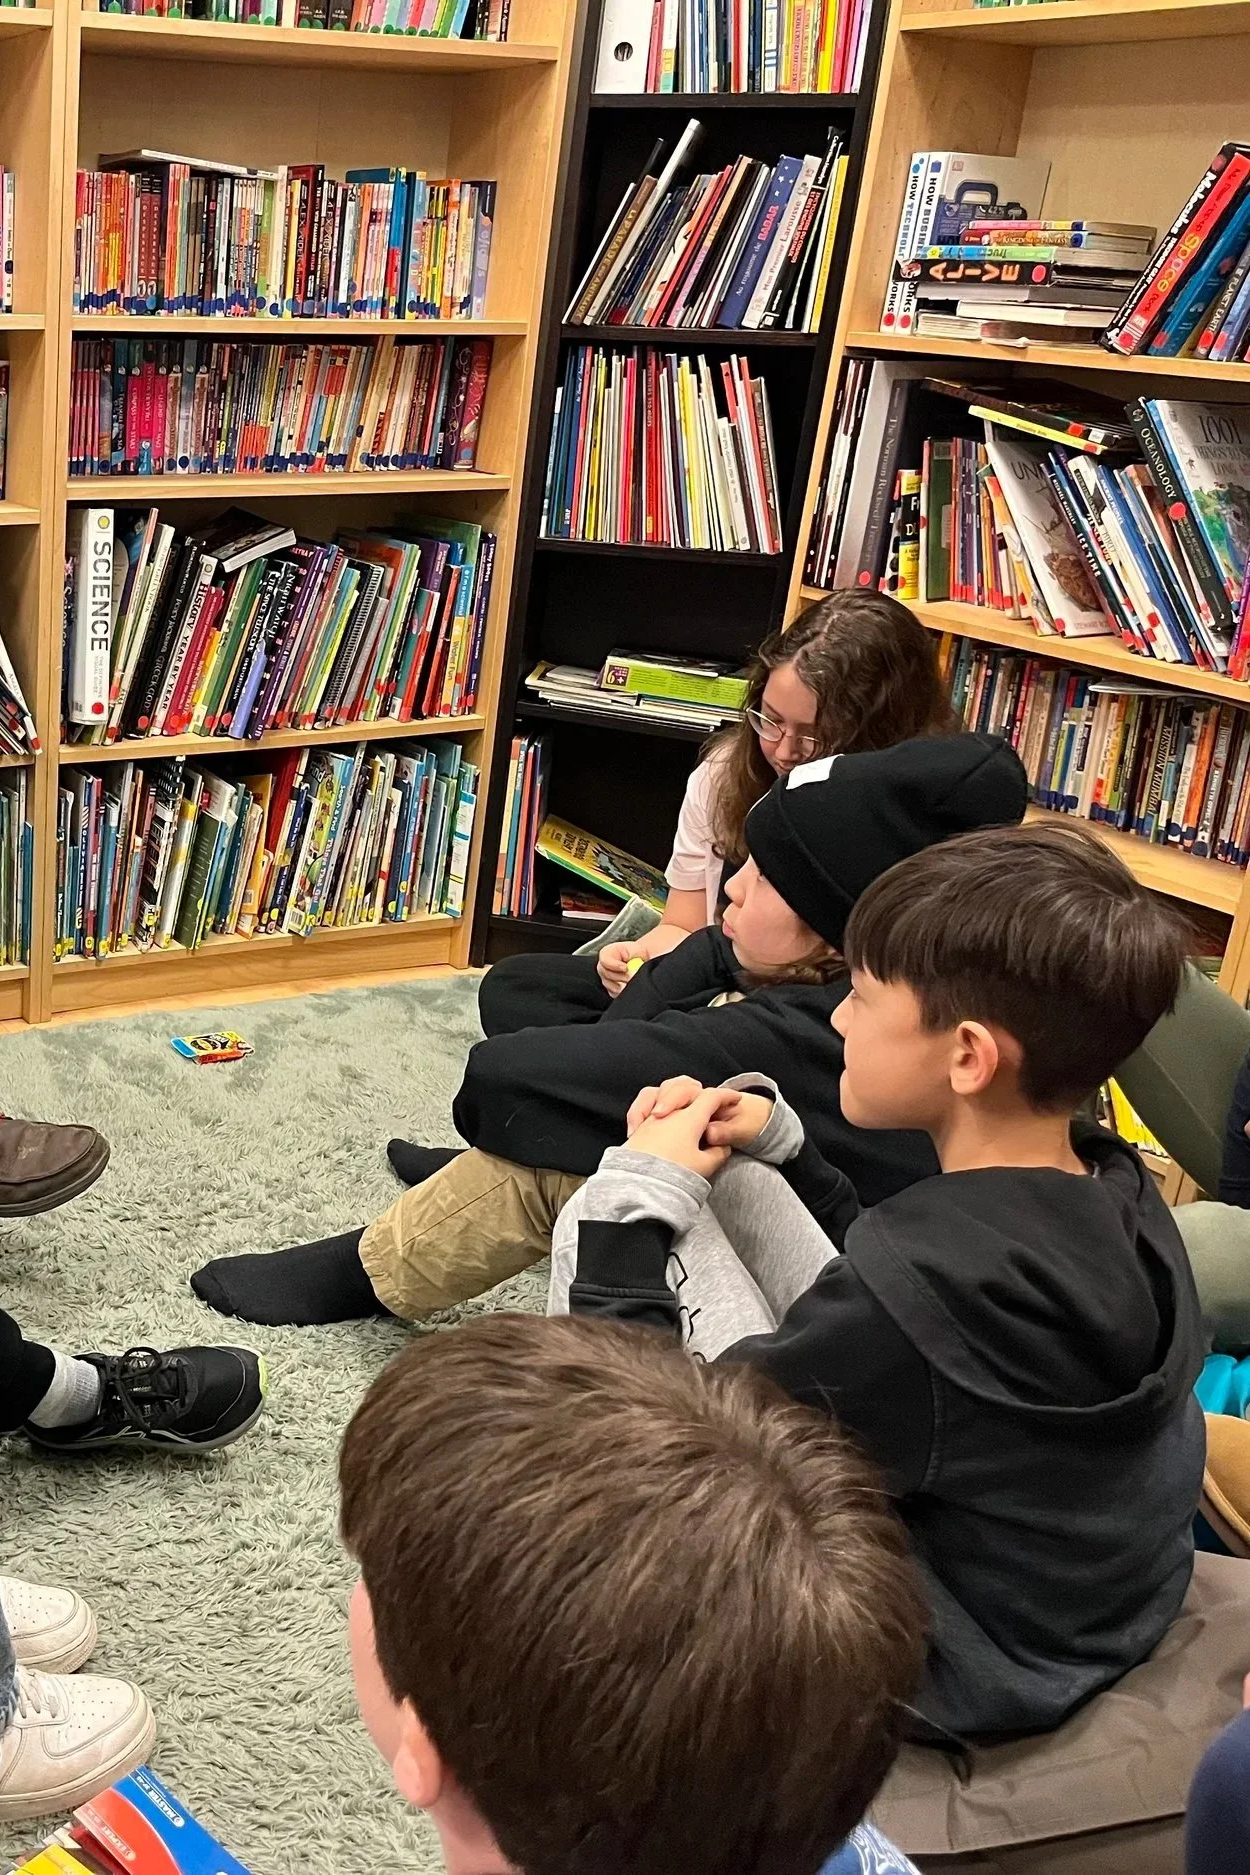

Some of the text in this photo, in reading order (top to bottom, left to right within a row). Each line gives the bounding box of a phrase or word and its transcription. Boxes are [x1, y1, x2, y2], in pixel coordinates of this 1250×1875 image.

[925, 176, 937, 206] HOW
[1170, 168, 1217, 239] Molecules
[627, 208, 635, 219] LA
[896, 174, 919, 257] HOW TECHNOL
[296, 201, 306, 262] ALEX RIDER
[602, 217, 630, 266] PARADE
[734, 285, 744, 296] Au
[756, 202, 780, 242] BABAR
[761, 198, 803, 291] Mon Premier Larousse
[929, 262, 1020, 281] ALIVE
[1143, 266, 1158, 284] GRAY
[1154, 232, 1202, 293] Space
[574, 275, 600, 320] ANIMAUX
[901, 281, 917, 313] ORKS
[1218, 275, 1238, 308] PLANET
[887, 414, 898, 434] The
[1198, 415, 1242, 445] 1001
[879, 437, 894, 476] Norman
[1139, 426, 1177, 500] OCEANOLOGY
[871, 478, 887, 521] Rockwell
[1099, 478, 1113, 501] ANCIENT
[1075, 532, 1101, 577] ICE TIME
[1099, 531, 1117, 554] BIRD
[91, 541, 112, 652] SCIENCE
[160, 581, 208, 710] History YEAR BY YEAR
[244, 614, 265, 652] TELESCOPE
[148, 654, 164, 687] GREEK
[446, 640, 460, 681] Water Fun
[1145, 725, 1172, 816] MISSION MUMBAI
[335, 784, 346, 808] Search
[1201, 769, 1222, 820] KENNETH OPPEL
[329, 816, 338, 831] Find
[320, 837, 334, 866] Things
[316, 866, 327, 887] That
[312, 888, 321, 903] Go!
[147, 1788, 177, 1818] MASTER
[100, 1824, 129, 1852] EXPERT
